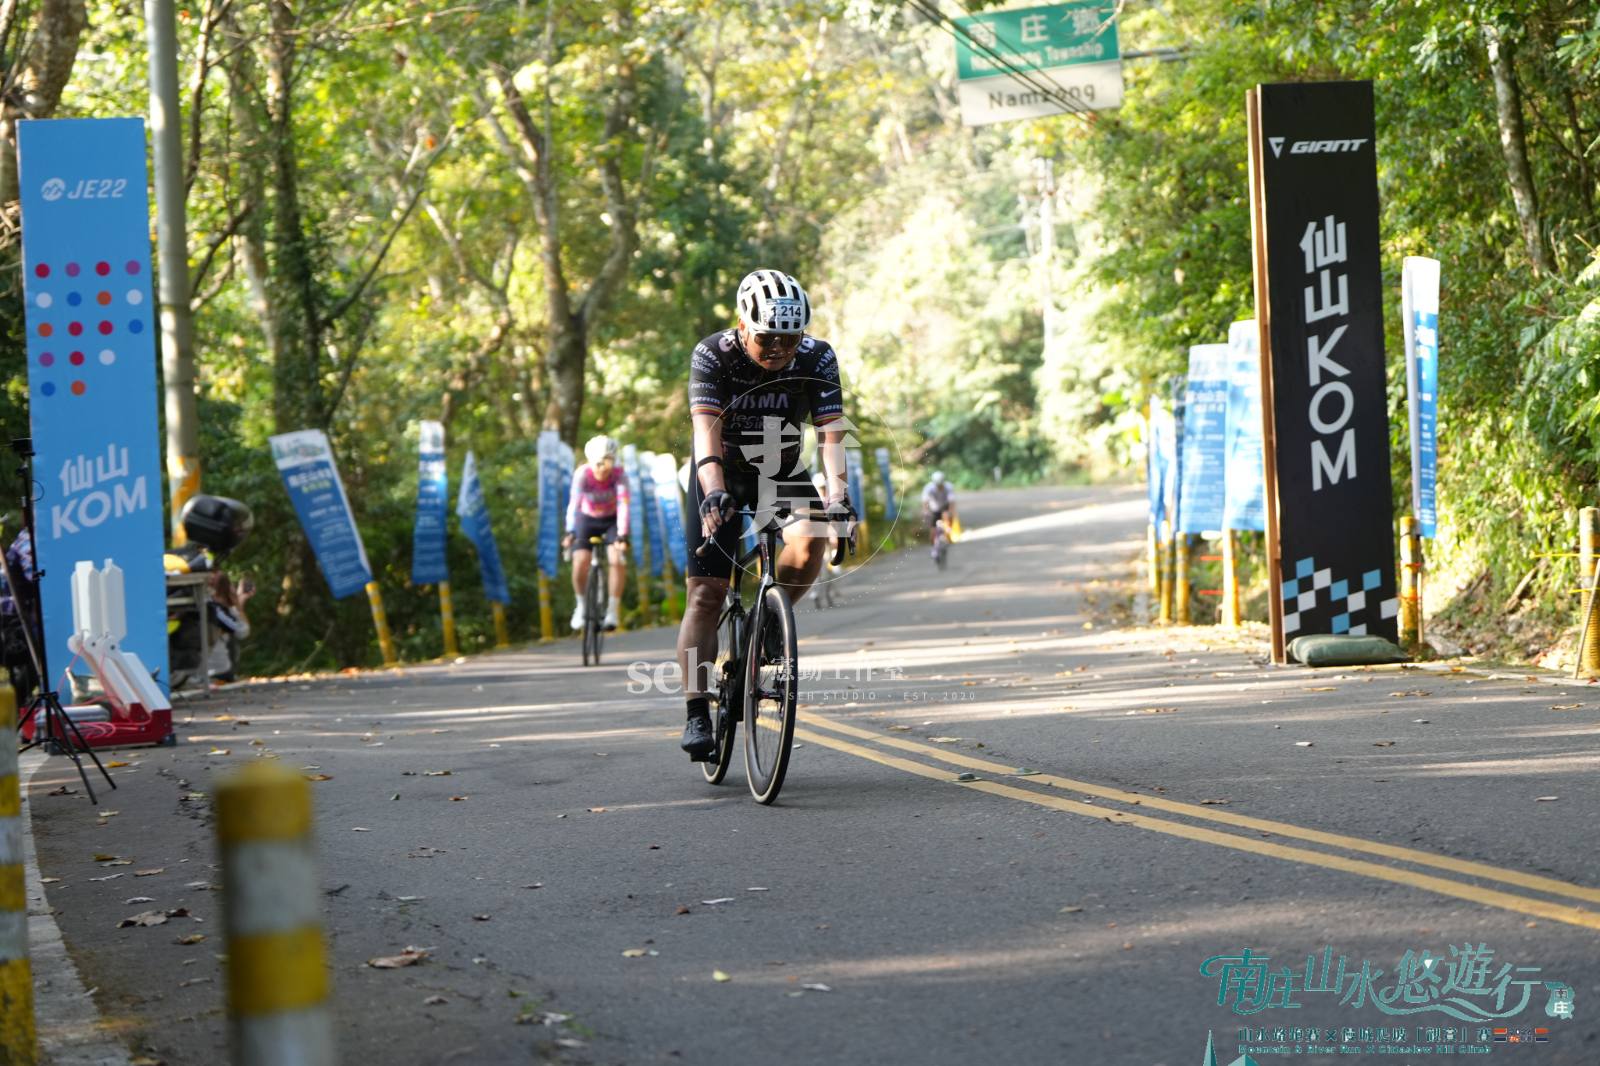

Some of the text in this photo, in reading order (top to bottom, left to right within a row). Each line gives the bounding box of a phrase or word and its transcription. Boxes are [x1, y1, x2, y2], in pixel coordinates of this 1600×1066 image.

[1290, 137, 1369, 155] GIANT
[67, 178, 128, 200] JE22
[731, 392, 789, 410] VISMA
[58, 443, 129, 497] 仙山
[51, 475, 148, 540] KOM
